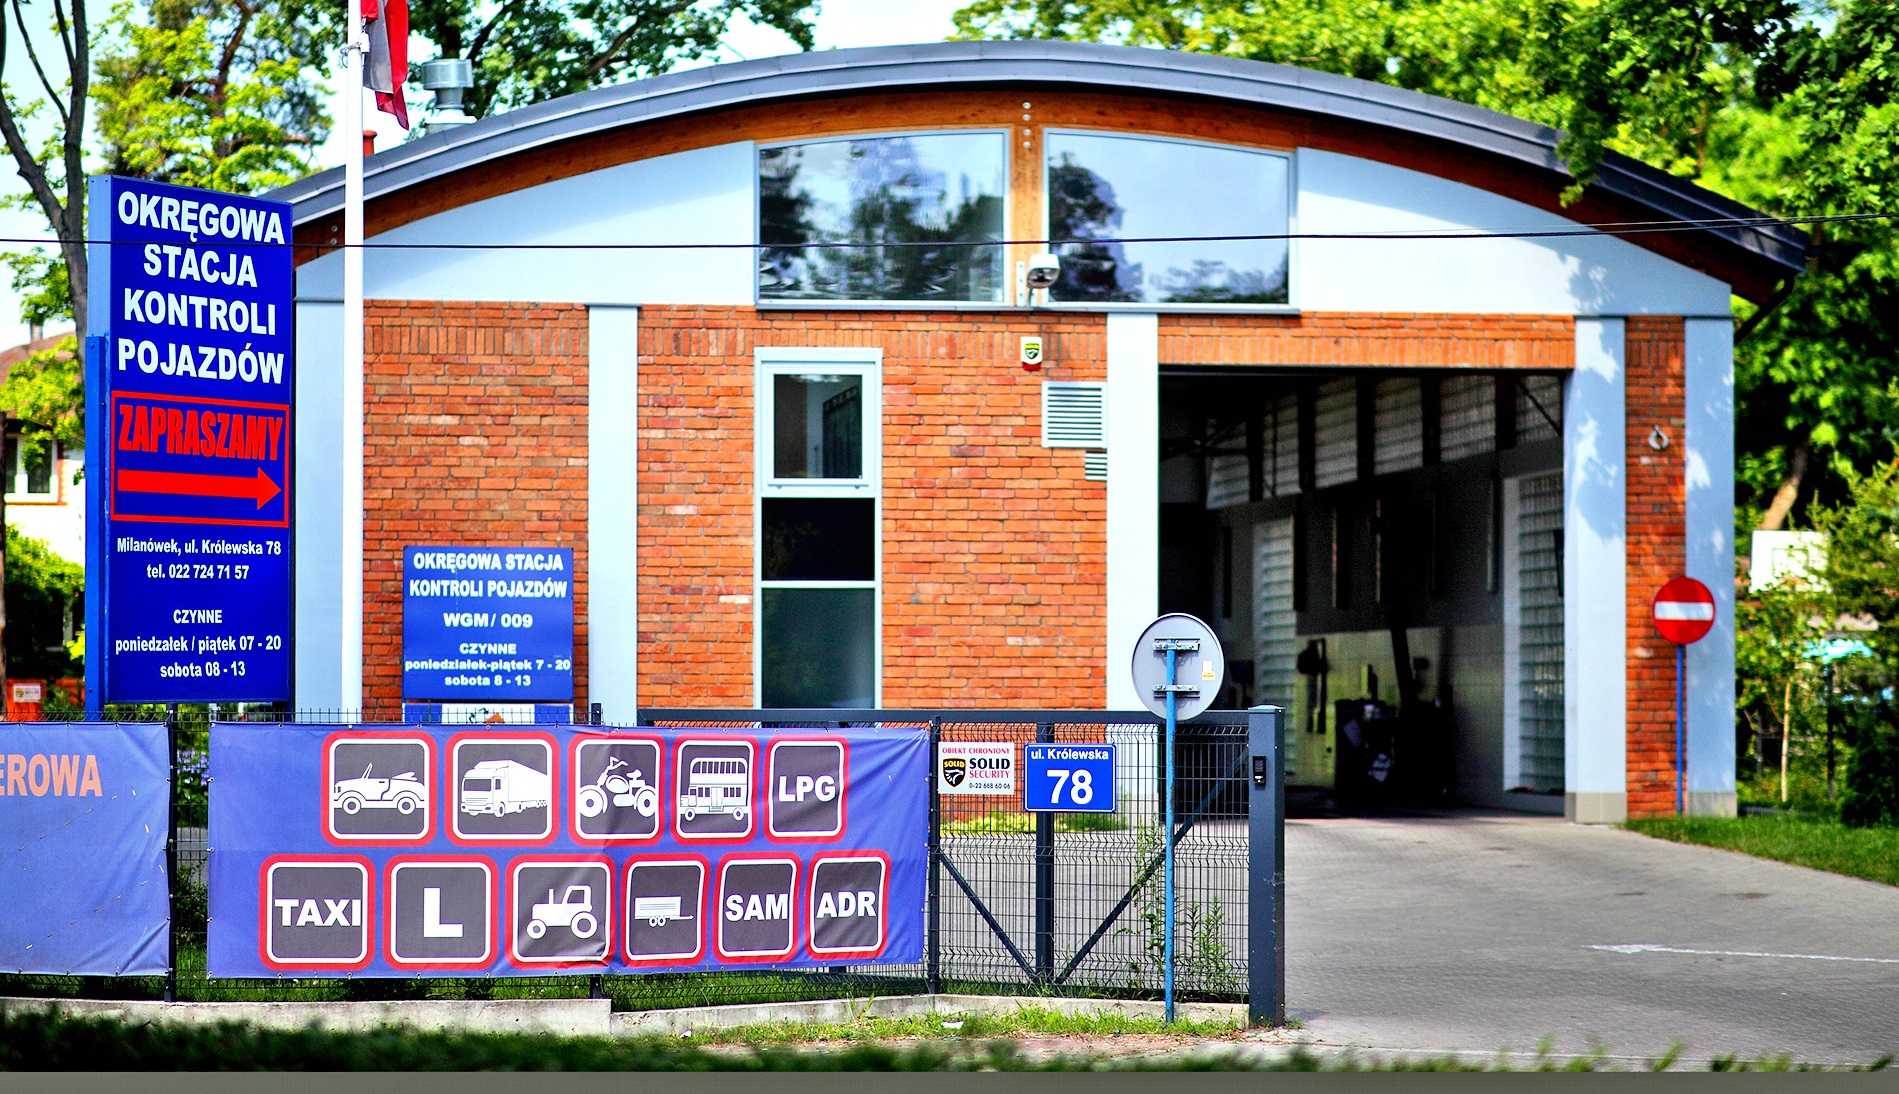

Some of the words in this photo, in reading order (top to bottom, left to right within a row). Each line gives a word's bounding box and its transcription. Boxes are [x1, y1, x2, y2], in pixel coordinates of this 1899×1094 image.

[118, 191, 285, 244] OKRĘGOWA
[143, 243, 258, 288] STACJA
[124, 287, 276, 336] KONTROLI
[118, 338, 284, 384] POJAZDÓW
[118, 404, 283, 461] ZAPRASZAMY
[117, 537, 182, 556] Milanówek,
[184, 539, 198, 554] ul.
[202, 540, 262, 554] Królewska
[266, 541, 282, 555] 78
[147, 564, 166, 578] tel.
[168, 564, 190, 578] 022
[193, 565, 214, 579] 724
[217, 565, 230, 579] 71
[234, 565, 250, 580] 57
[414, 552, 502, 573] OKRĘGOWA
[506, 554, 564, 570] STACJA
[410, 580, 483, 596] KONTROLI
[488, 578, 567, 598] POJAZDÓW
[173, 609, 222, 624] CZYNNE
[501, 614, 533, 628] 009
[116, 636, 188, 655] poniedzałek
[198, 636, 236, 654] piątek
[240, 636, 254, 650] 07
[266, 635, 282, 650] 20
[460, 644, 516, 654] CZYNNE
[160, 662, 202, 677] sobota
[206, 662, 220, 676] 08
[230, 661, 246, 676] 13
[536, 660, 544, 670] 7
[556, 660, 570, 670] 20
[444, 675, 490, 686] sobota
[494, 675, 502, 686] 8
[515, 676, 531, 686] 13
[970, 758, 1010, 769] SOLID
[1031, 748, 1044, 760] ul.
[1048, 748, 1108, 760] Królewska
[970, 770, 1010, 778] SECURITY
[778, 775, 836, 802] LPG
[1046, 769, 1093, 804] 78
[274, 899, 361, 926] TAXI
[423, 888, 462, 938] L
[725, 893, 788, 922] SAM
[816, 891, 876, 918] ADR
